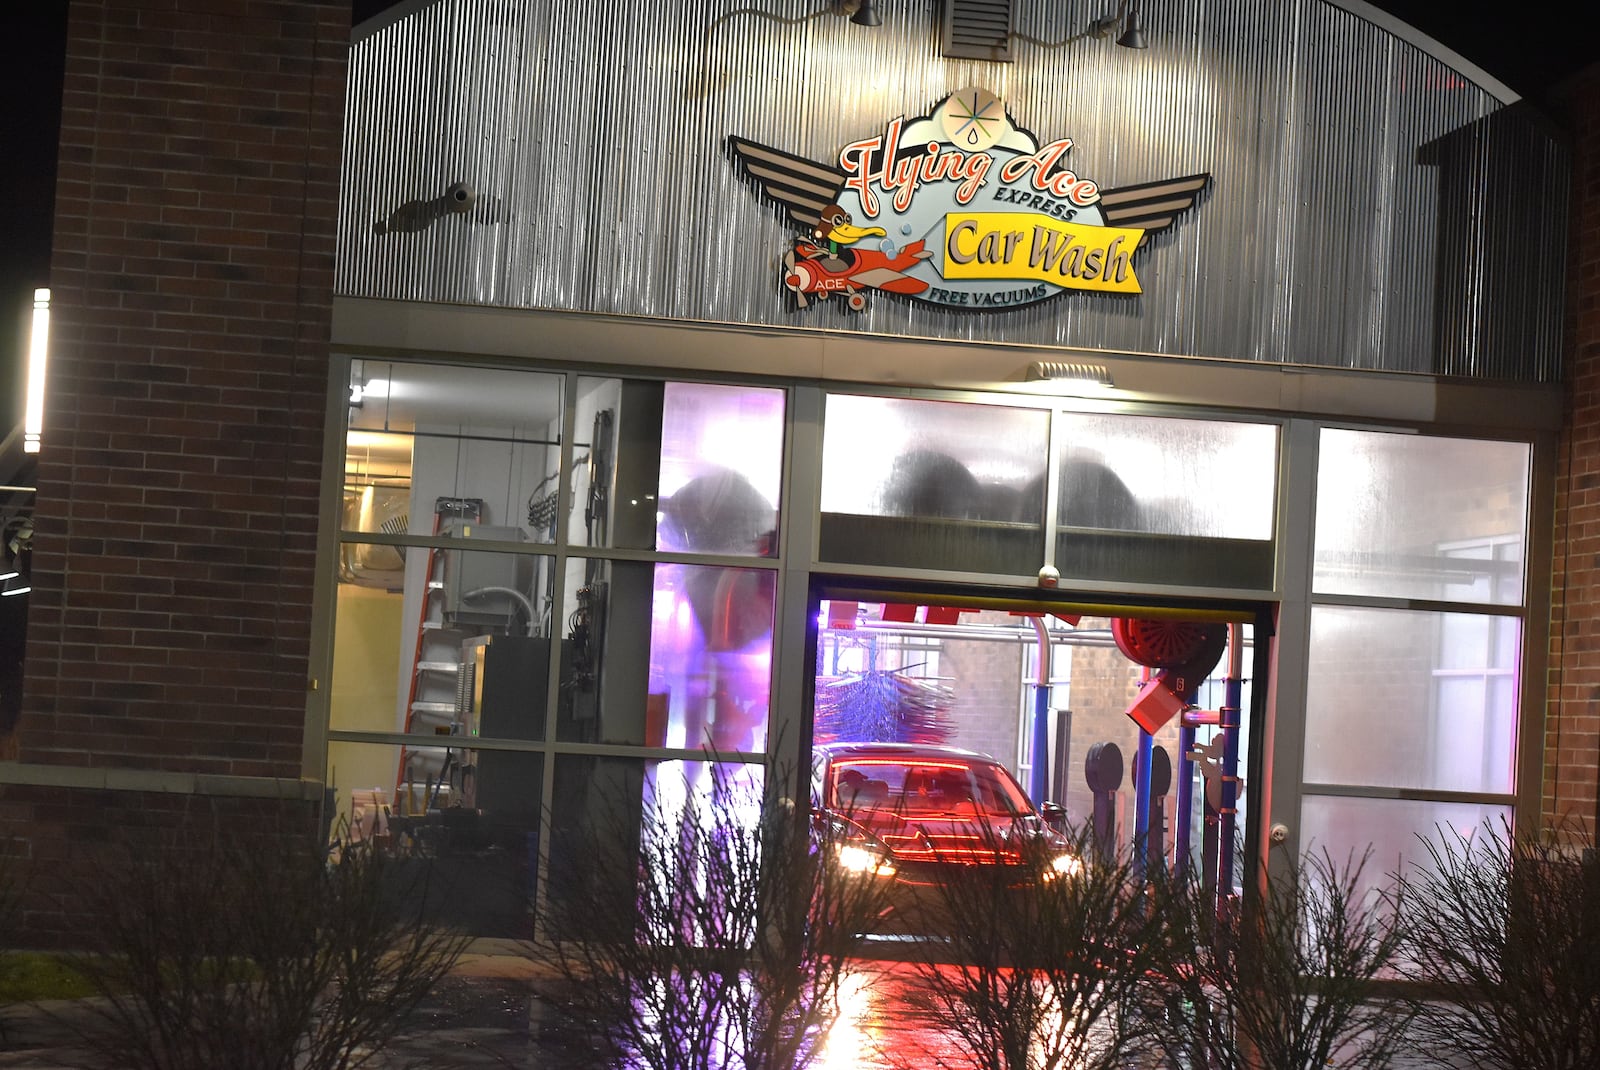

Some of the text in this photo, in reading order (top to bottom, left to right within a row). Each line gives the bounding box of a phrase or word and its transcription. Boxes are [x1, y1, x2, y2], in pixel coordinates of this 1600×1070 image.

[840, 116, 1100, 217] Flying Ace
[993, 187, 1077, 221] EXPRESS
[948, 220, 1128, 283] Car Wash
[814, 279, 845, 291] ACE
[929, 284, 1047, 305] FREE VACUUMS
